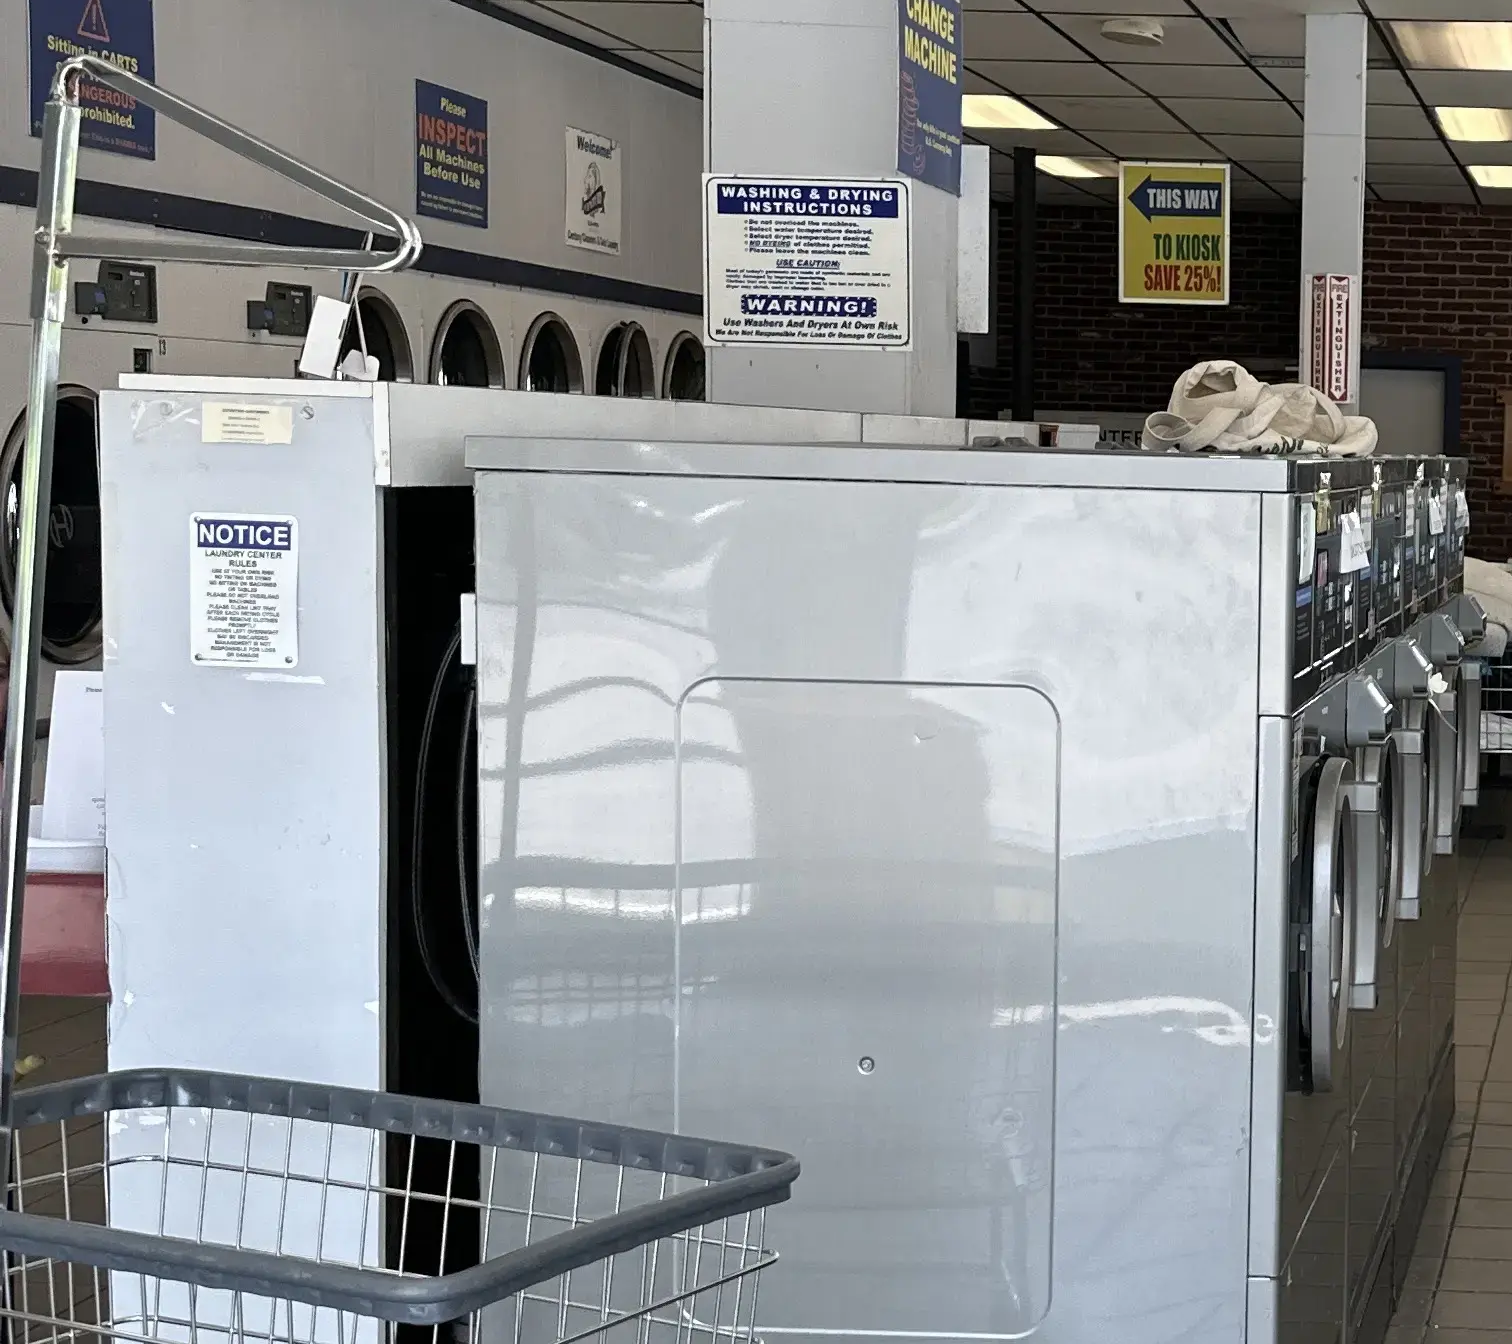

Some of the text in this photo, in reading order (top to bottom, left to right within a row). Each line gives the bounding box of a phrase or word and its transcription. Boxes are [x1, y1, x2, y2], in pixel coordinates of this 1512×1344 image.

[47, 35, 85, 58] Sitting
[101, 50, 138, 73] CARTS
[904, 25, 957, 85] MACHINE
[77, 84, 137, 111] NGEROUS
[441, 96, 466, 118] Please
[419, 113, 486, 155] INSPECT
[420, 144, 485, 174] All Machines
[424, 162, 480, 189] Before Use
[722, 186, 893, 201] WASHING & DRYING
[1147, 188, 1219, 210] THIS WAY
[744, 201, 873, 215] INSTRUCTIONS
[1153, 233, 1221, 261] TO KIOSK
[776, 259, 794, 267] USE
[1144, 264, 1221, 292] SAVE 25%!
[1332, 284, 1348, 293] FIRE
[747, 298, 867, 313] WARNING!
[723, 318, 898, 330] Use Washers And Dryers At Own Risk
[1335, 294, 1343, 392] EXTINGUISHER
[199, 523, 289, 547] NOTICE
[247, 551, 282, 559] CENTER
